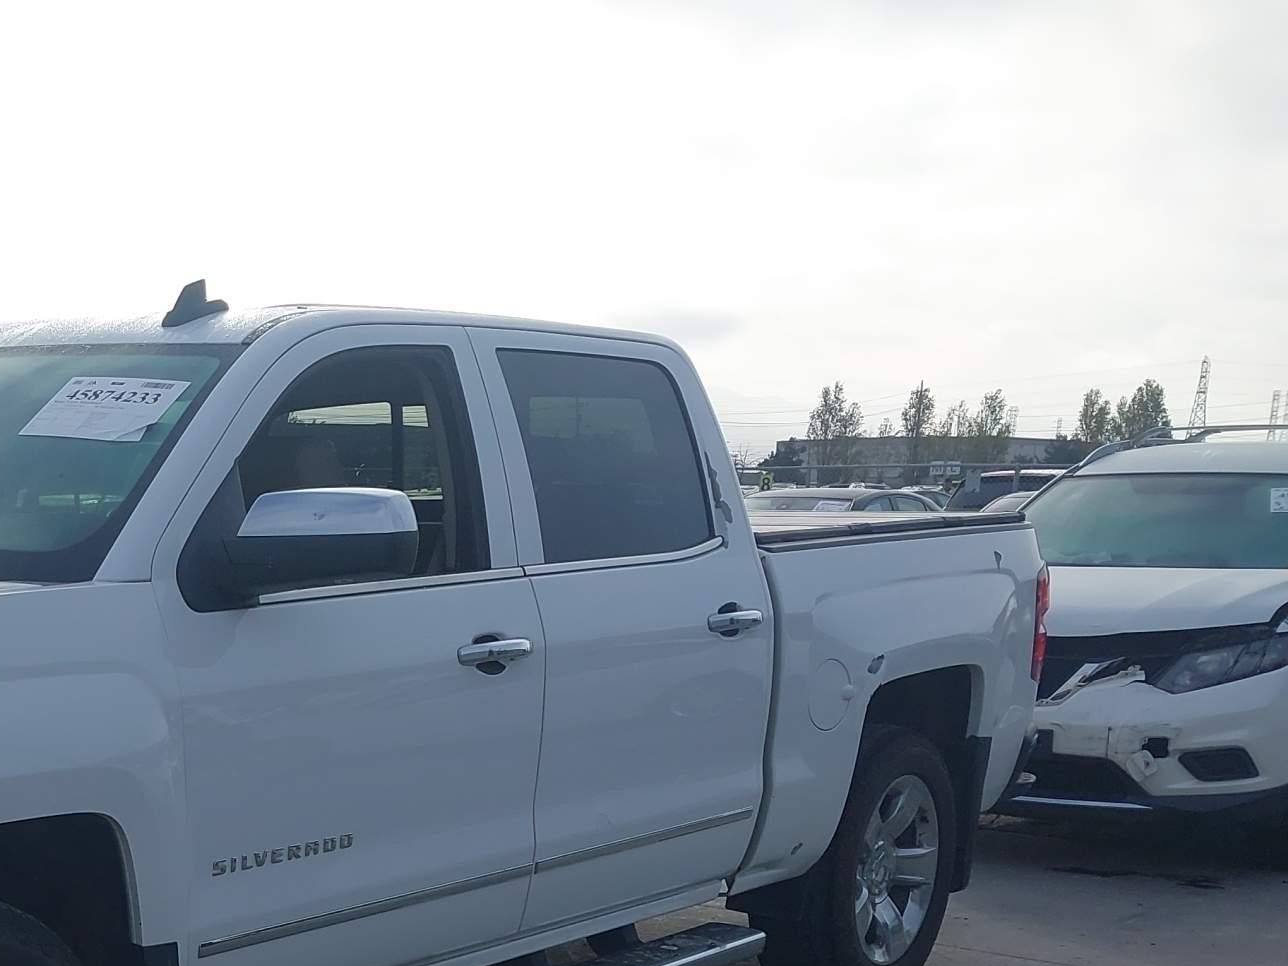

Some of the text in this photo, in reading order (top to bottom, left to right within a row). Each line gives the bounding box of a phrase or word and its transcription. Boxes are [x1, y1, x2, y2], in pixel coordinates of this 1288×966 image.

[65, 388, 162, 405] 45874233
[760, 476, 772, 492] 8
[211, 832, 354, 877] SILVERADO
